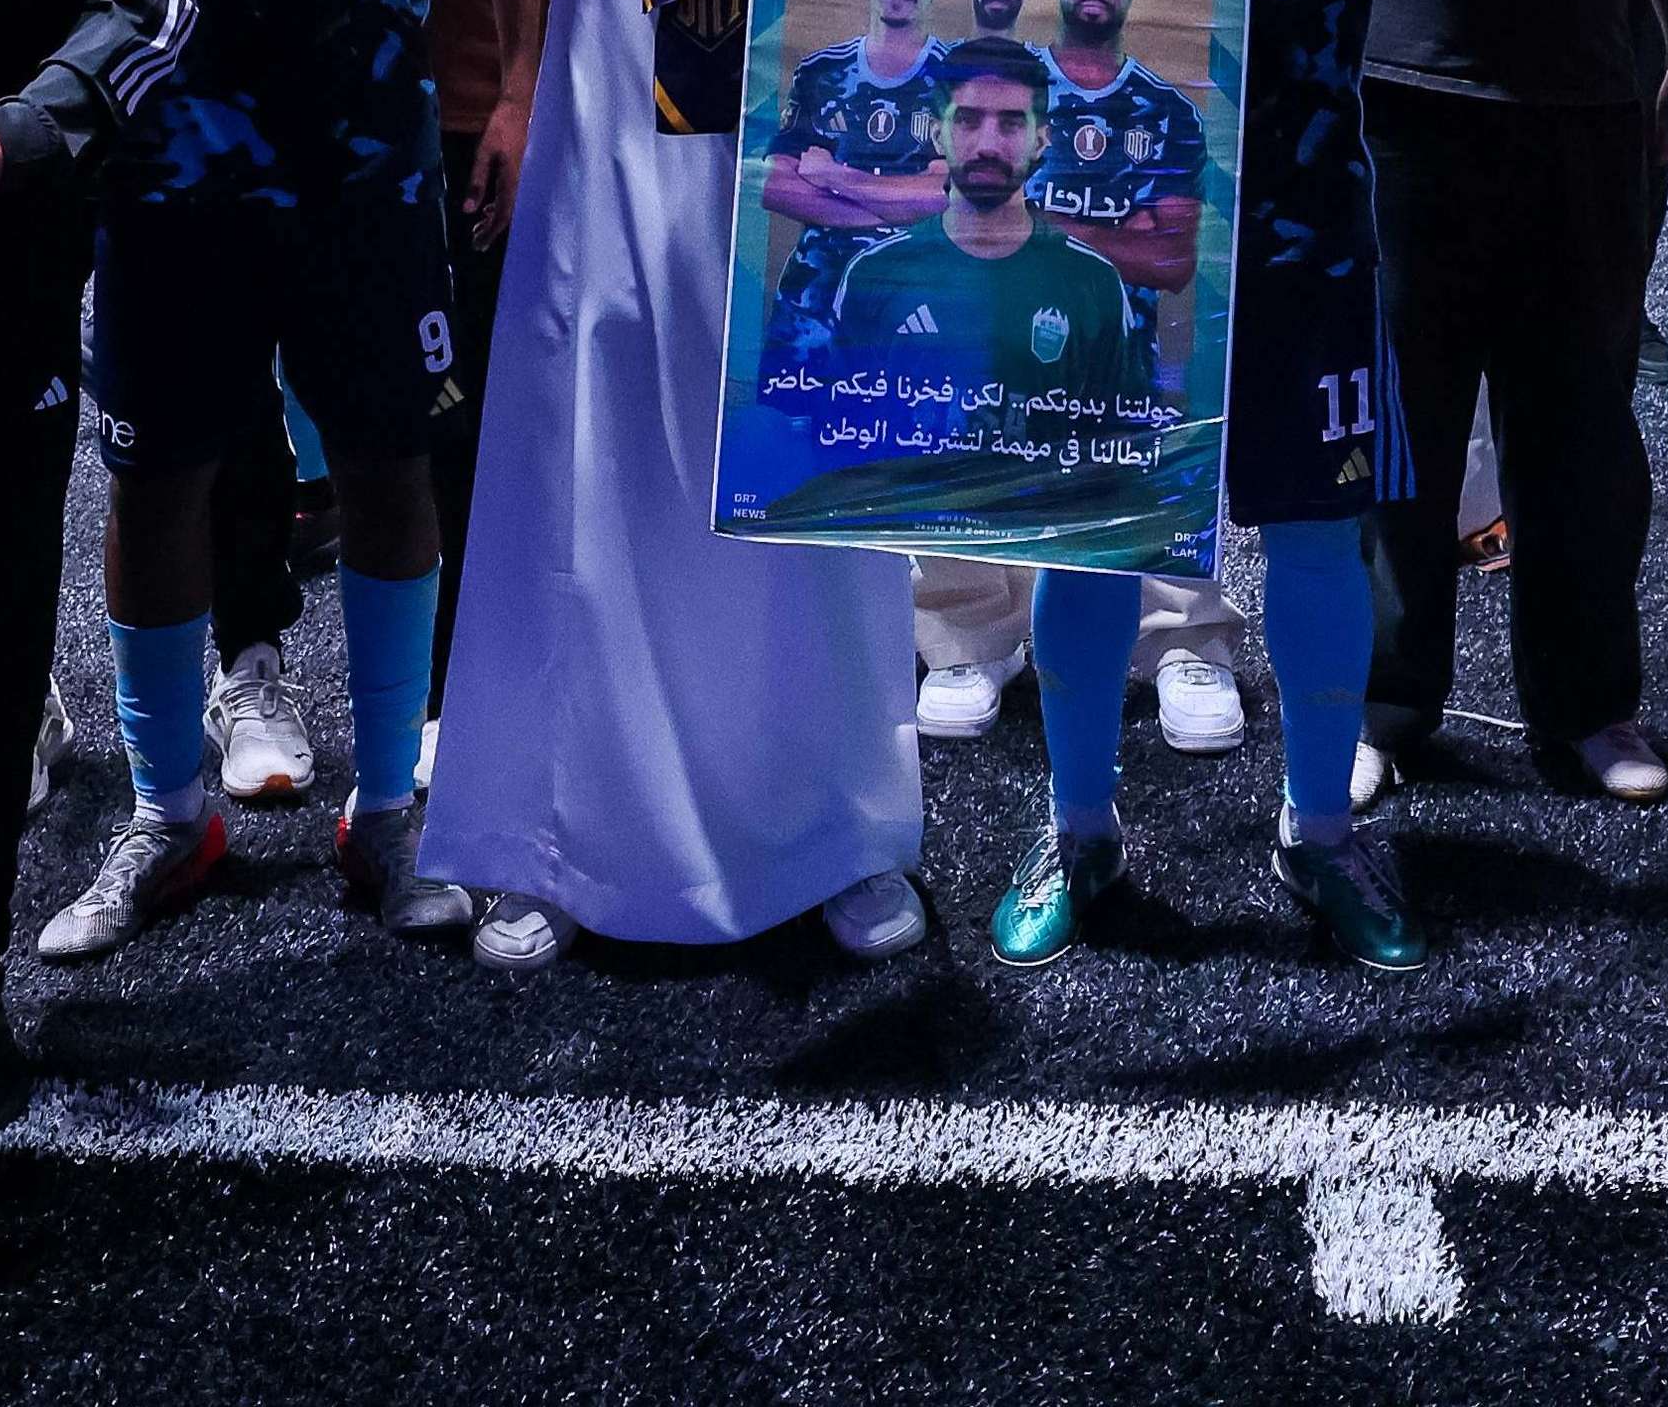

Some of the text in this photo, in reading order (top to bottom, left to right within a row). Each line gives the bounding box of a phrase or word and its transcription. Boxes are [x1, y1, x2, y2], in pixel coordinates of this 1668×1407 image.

[418, 311, 453, 373] 9
[763, 366, 824, 394] حاضر
[831, 370, 888, 403] فيكم
[897, 375, 954, 407] فخرنا
[961, 382, 1004, 411] لكن
[1318, 368, 1375, 442] 11
[819, 416, 1162, 474] أبطالنا في مهمة لتشريف الوطن
[733, 507, 767, 520] NEWS
[734, 493, 757, 503] DR7
